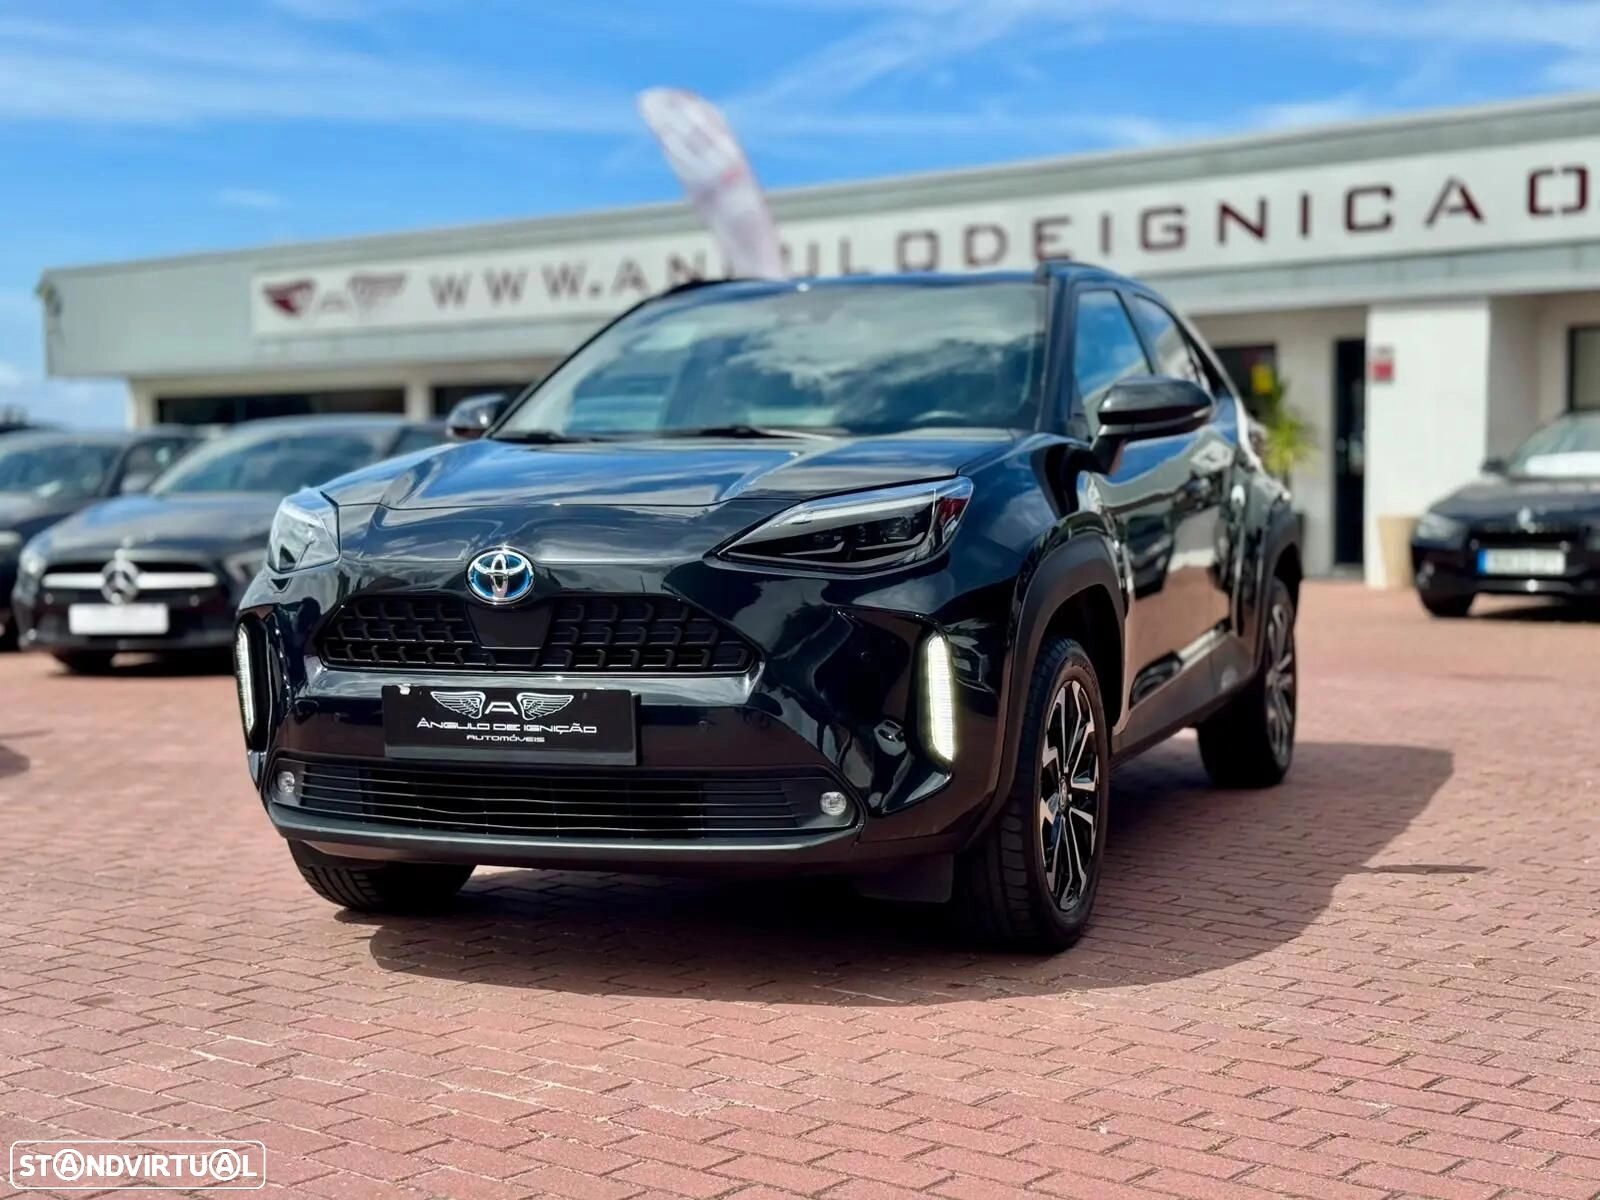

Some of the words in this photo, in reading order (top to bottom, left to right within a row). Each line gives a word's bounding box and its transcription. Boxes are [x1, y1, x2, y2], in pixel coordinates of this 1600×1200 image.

[429, 164, 1588, 311] WWW.ANULODEIGNICAO
[484, 701, 519, 715] A
[416, 717, 490, 731] ÂNGULO
[493, 723, 521, 732] DE
[523, 722, 598, 735] IGNIÇÃO
[466, 734, 546, 743] AUTOMÓVEIS
